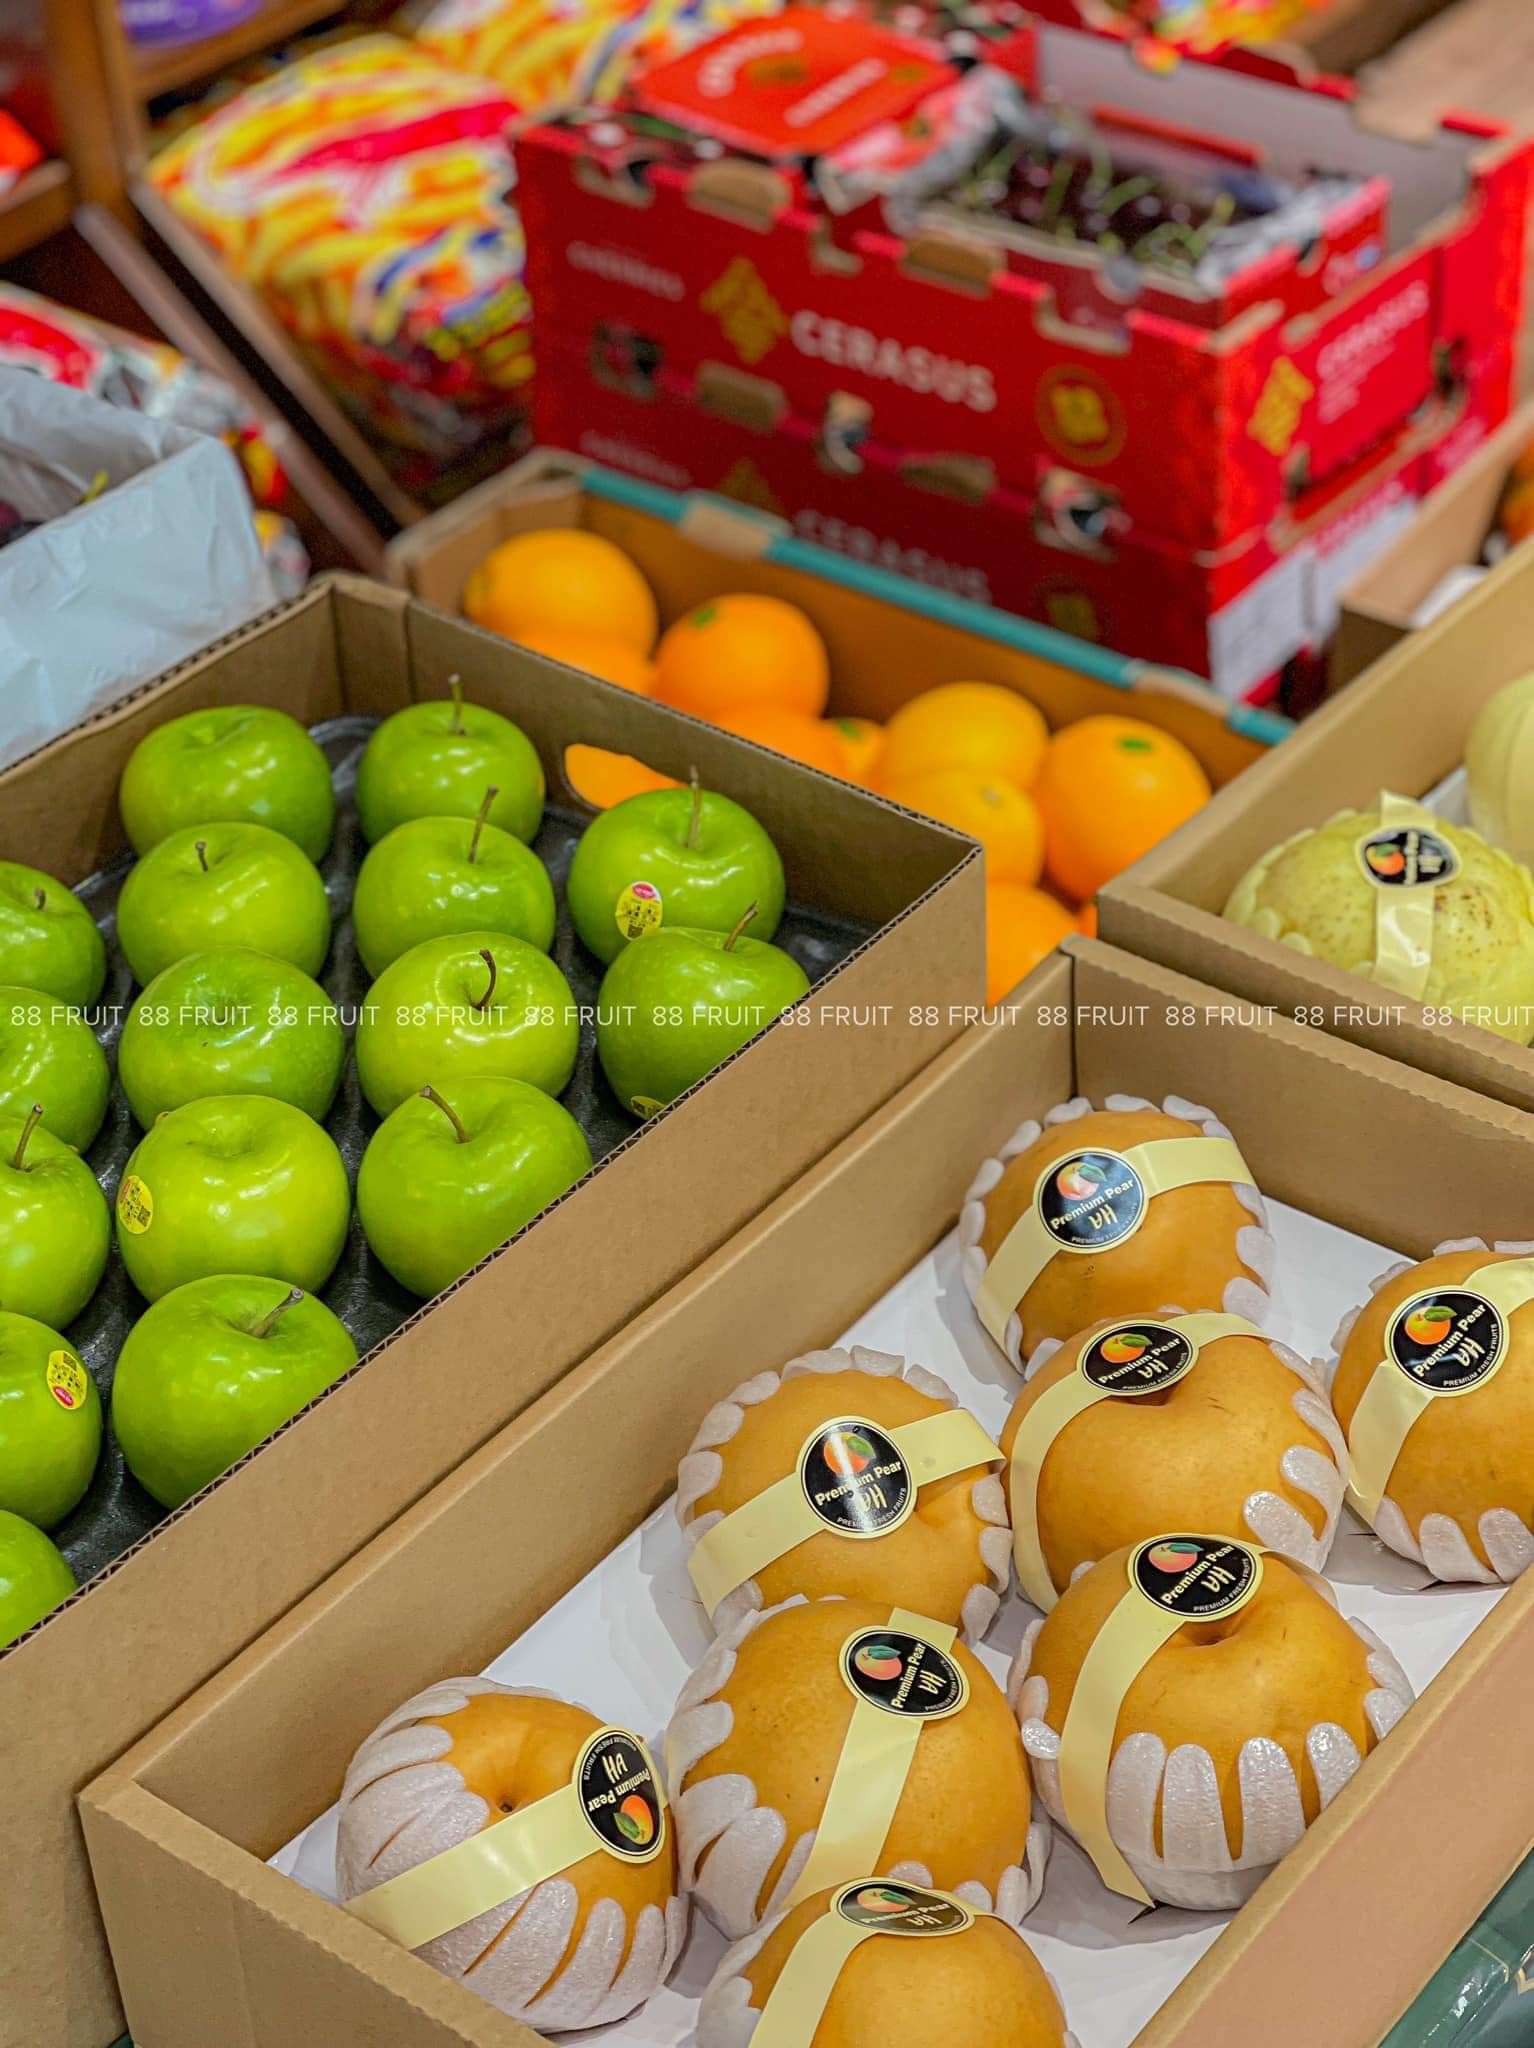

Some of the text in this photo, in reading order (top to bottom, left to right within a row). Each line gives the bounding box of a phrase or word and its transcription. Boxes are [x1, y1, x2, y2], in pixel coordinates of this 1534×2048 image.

[790, 309, 997, 413] CERASUS
[1050, 1195, 1105, 1230] Premium
[1105, 1179, 1134, 1199] Pear
[1097, 1337, 1181, 1384] Premium Pear
[1413, 1304, 1487, 1377] Premium Pear
[1443, 1372, 1478, 1387] PREMIUM
[873, 1461, 903, 1478] Pear
[1160, 1545, 1235, 1605] Premium Pear
[1193, 1598, 1230, 1612] PREMIUM
[1229, 1577, 1248, 1599] FRESH
[890, 1643, 927, 1709] Premium Pear
[587, 1767, 652, 1812] Premium Pear
